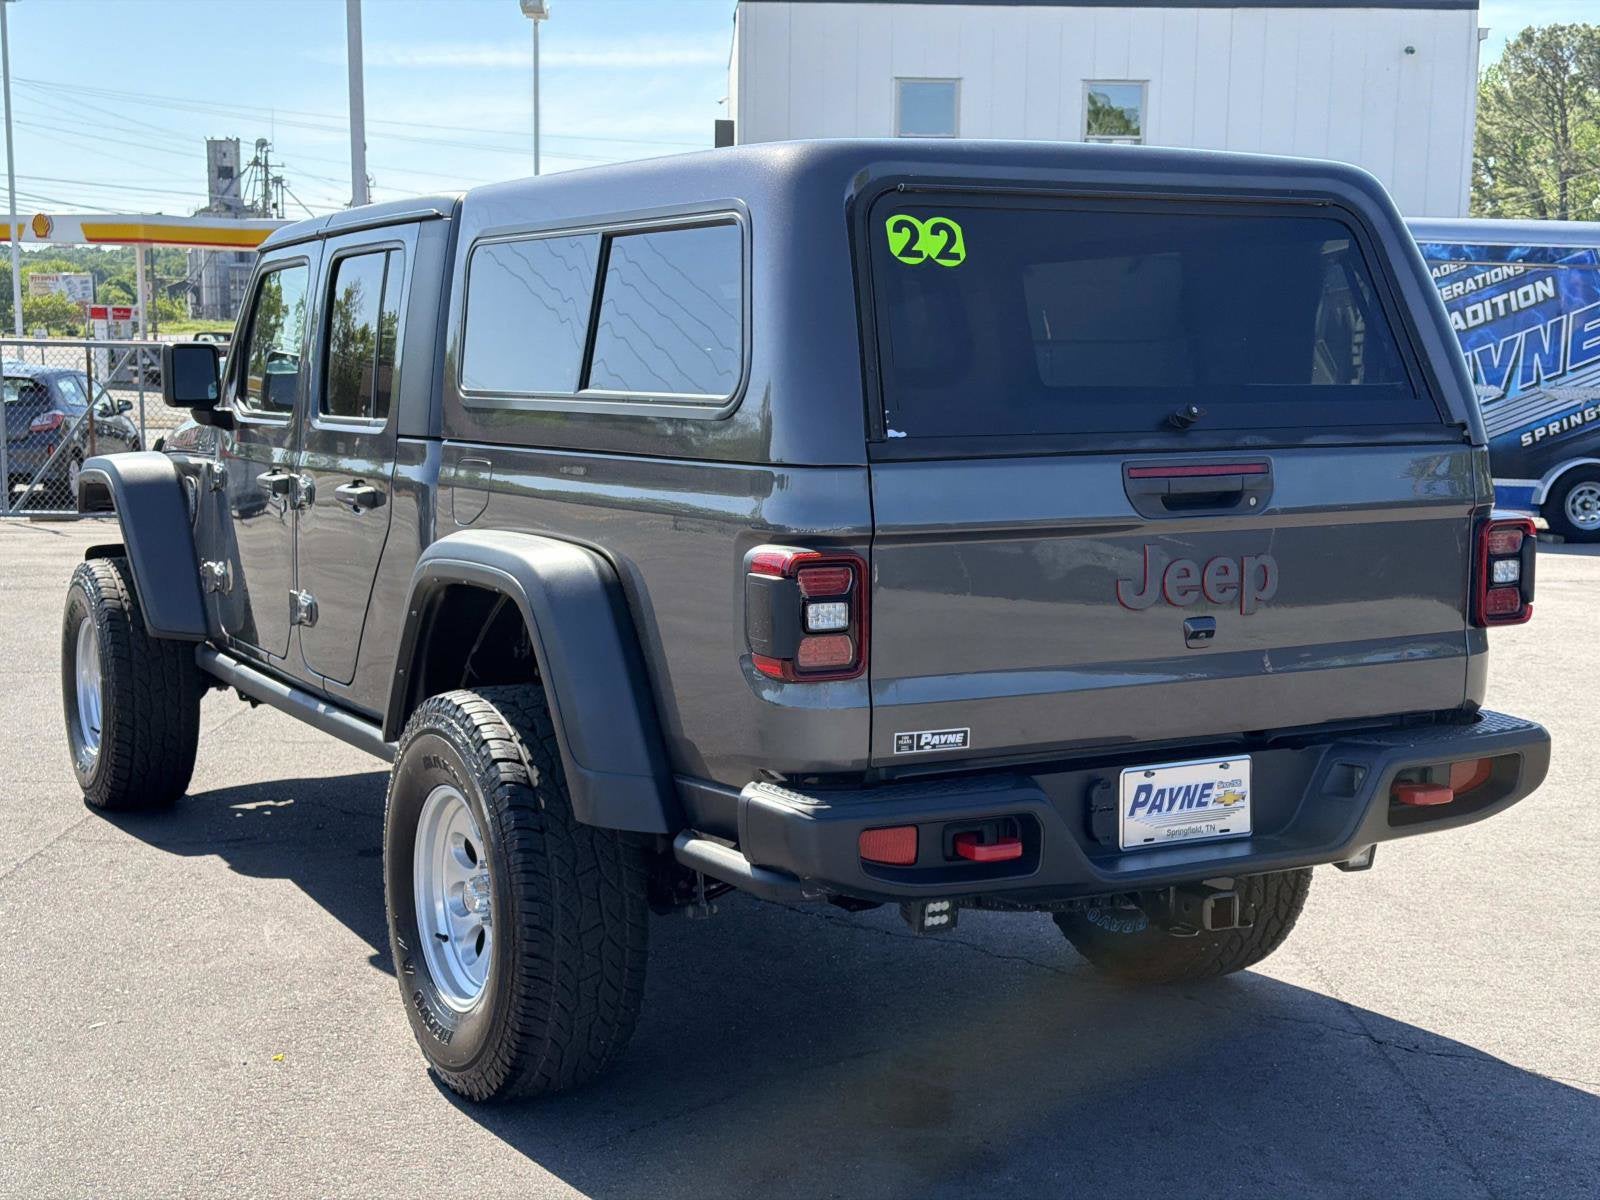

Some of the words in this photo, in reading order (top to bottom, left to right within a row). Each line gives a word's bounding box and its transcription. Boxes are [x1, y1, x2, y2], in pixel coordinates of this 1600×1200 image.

[893, 219, 961, 261] 22
[1432, 257, 1467, 280] ADES
[1450, 277, 1555, 330] ADITION
[1464, 302, 1600, 404] YNE
[1521, 404, 1600, 447] SPRING
[1116, 543, 1279, 616] Jeep
[920, 733, 964, 746] PAYNE
[1128, 782, 1215, 817] PAYNE
[1166, 825, 1204, 839] Springfield,
[1205, 824, 1216, 832] TN
